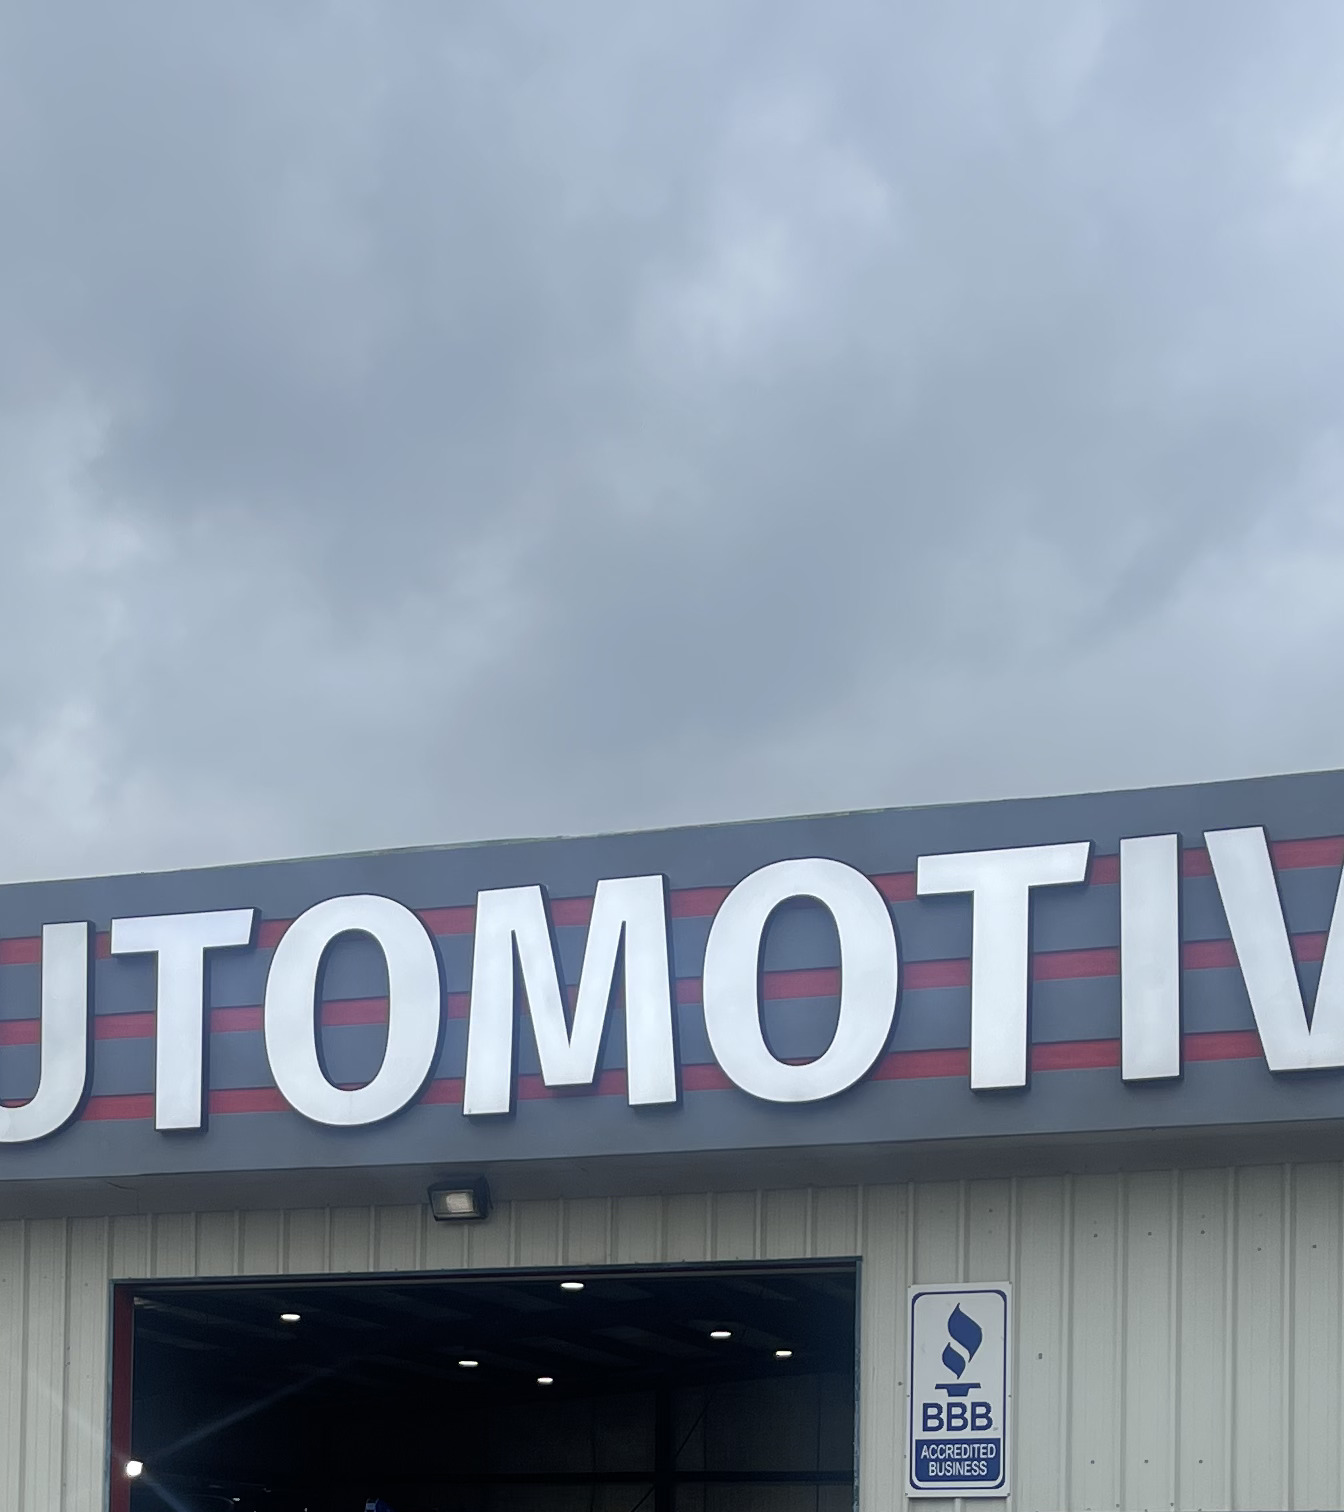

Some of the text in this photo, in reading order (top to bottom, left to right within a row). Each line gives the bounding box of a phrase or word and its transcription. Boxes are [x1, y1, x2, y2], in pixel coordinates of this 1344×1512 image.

[922, 1401, 994, 1433] BBB
[920, 1444, 997, 1459] ACCREDITED
[928, 1461, 988, 1476] BUSINESS
